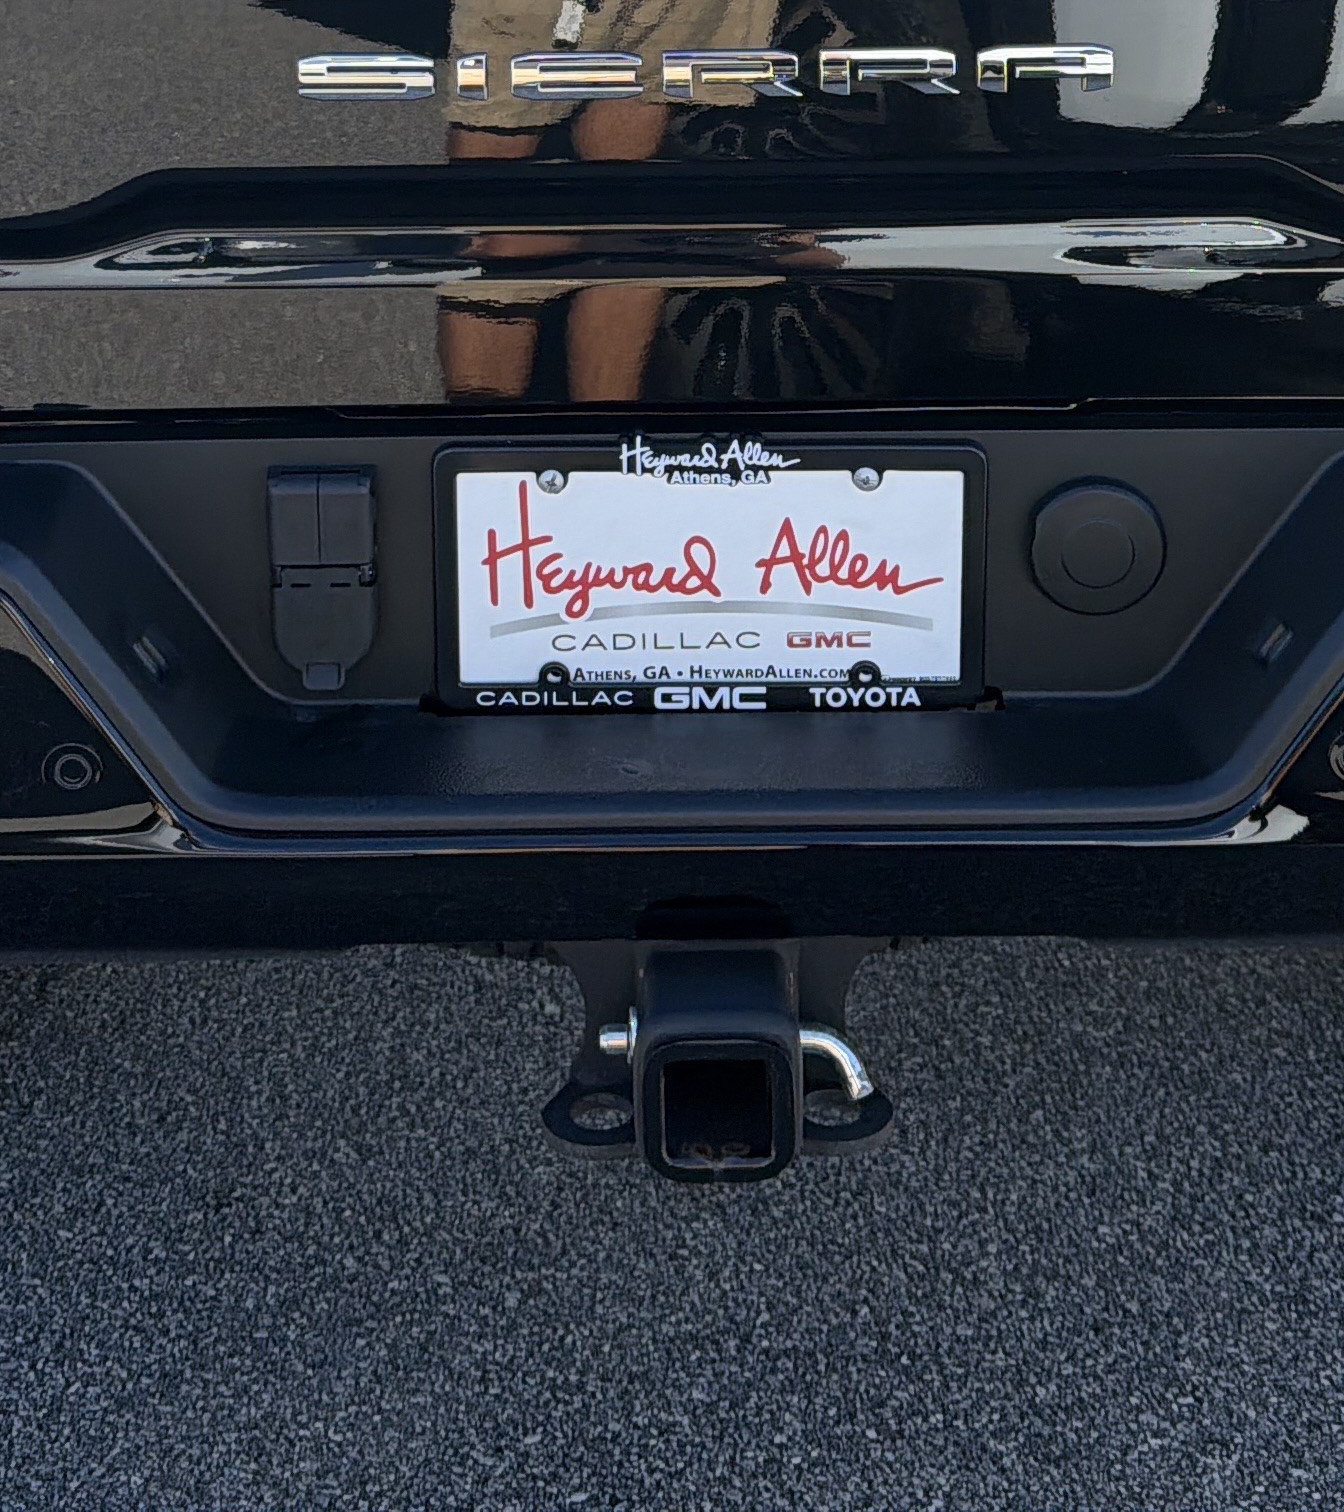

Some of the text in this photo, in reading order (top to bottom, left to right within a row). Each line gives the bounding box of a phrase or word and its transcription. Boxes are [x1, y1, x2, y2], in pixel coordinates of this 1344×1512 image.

[297, 44, 1113, 101] SIERRA
[619, 435, 801, 478] Heyward Allen
[670, 470, 768, 487] Athens, GA
[481, 479, 944, 619] Heyward Allen
[551, 630, 872, 652] CADILLAC GMC
[644, 665, 671, 680] GA
[476, 686, 921, 710] CADILLAC GMC TOYOTA
